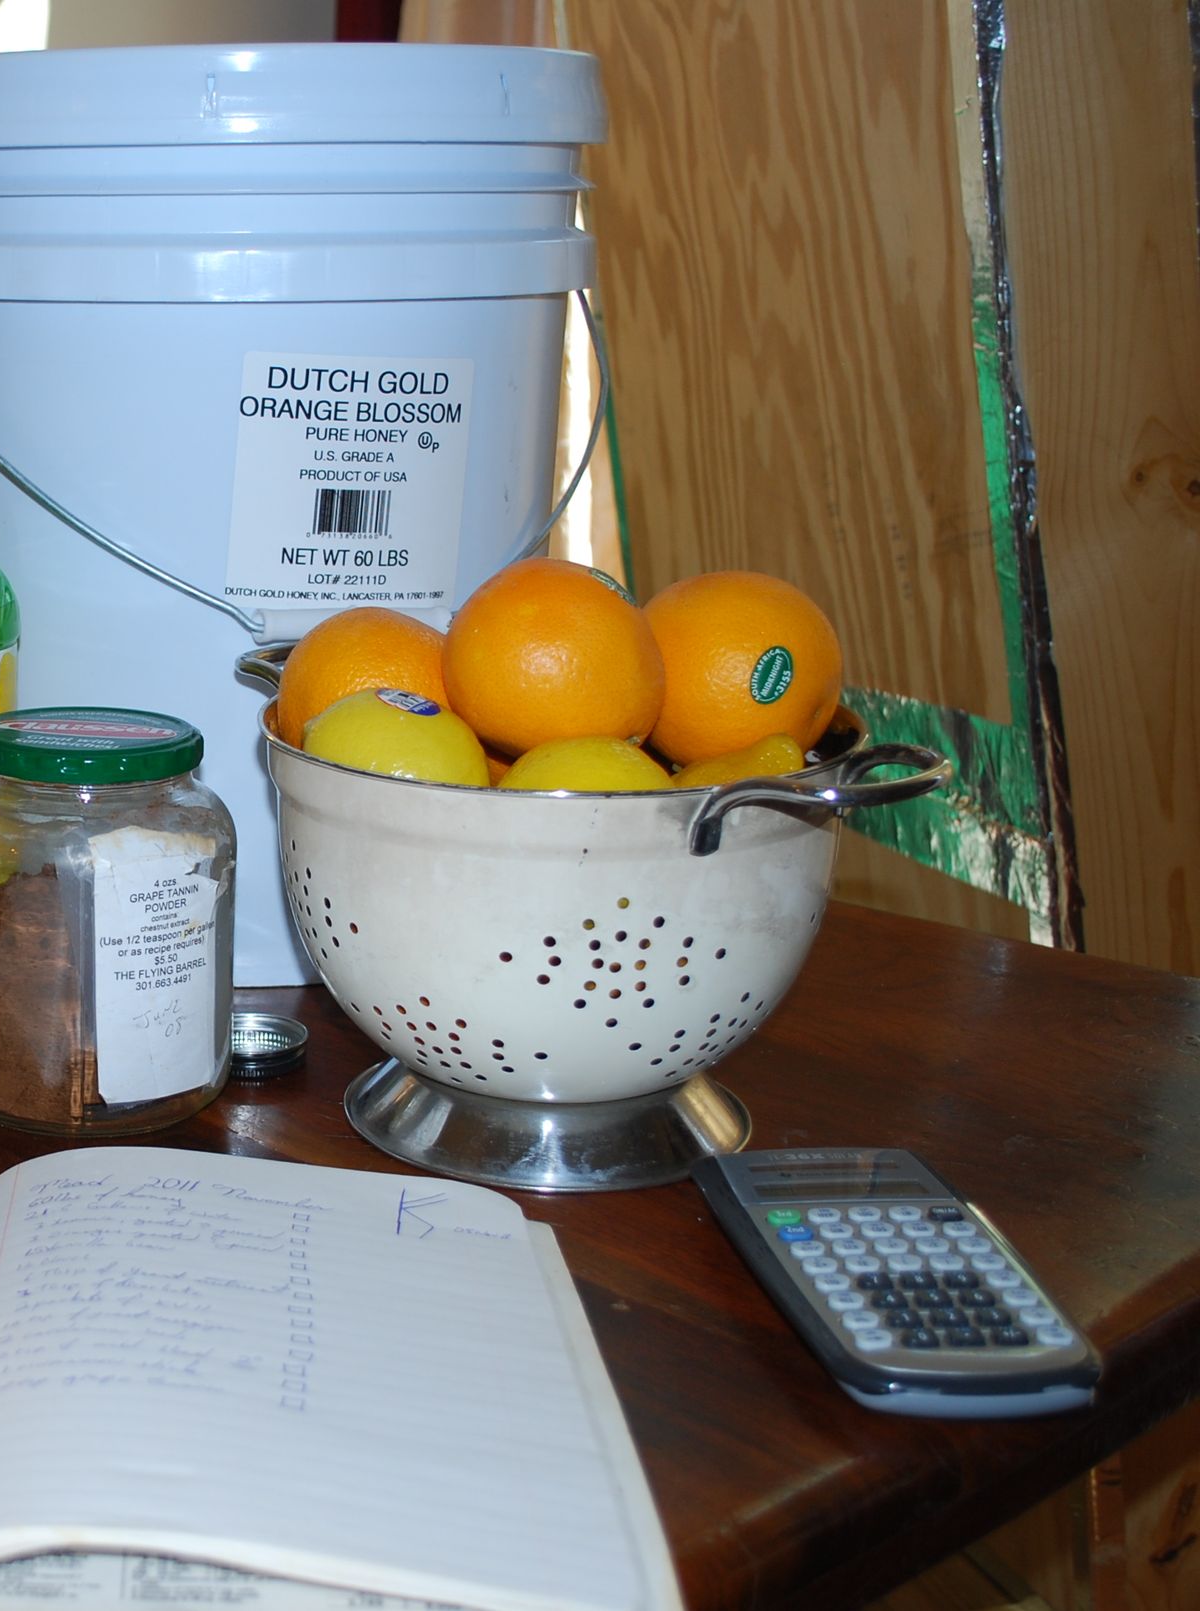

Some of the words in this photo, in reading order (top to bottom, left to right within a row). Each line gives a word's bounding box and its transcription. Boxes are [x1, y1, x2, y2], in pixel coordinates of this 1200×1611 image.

[267, 366, 369, 393] DUTCH
[378, 371, 449, 395] GOLD
[239, 396, 349, 421] ORANGE
[356, 402, 461, 423] BLOSSOM
[305, 427, 350, 442] PURE
[353, 429, 408, 443] HONEY
[314, 450, 337, 462] U.S.
[341, 451, 383, 463] GRADE
[386, 452, 395, 463] A
[300, 469, 361, 482] PRODUCT
[364, 471, 381, 482] OF
[383, 471, 407, 483] USA
[281, 547, 318, 565] NET
[323, 549, 349, 566] WT
[354, 550, 374, 567] 60
[378, 550, 409, 567] LBS
[307, 574, 341, 585] LOT#
[344, 574, 387, 585] 22111D
[224, 587, 256, 597] DUTCH
[259, 589, 285, 599] GOLD
[394, 592, 404, 600] PA
[756, 648, 781, 671] AFRICA
[760, 655, 783, 697] MIDKNIGHT
[154, 880, 160, 888] 4
[130, 890, 164, 903] GRAPE
[167, 884, 199, 898] TANNIN
[145, 898, 187, 913] POWDER
[140, 922, 169, 933] chestnut
[170, 918, 190, 929] extract
[151, 912, 178, 923] contains
[100, 937, 123, 948] (Use
[126, 935, 141, 945] 1/2
[143, 931, 182, 945] teaspoon
[183, 928, 196, 939] per
[197, 920, 215, 935] gallon
[118, 948, 129, 957] or
[131, 947, 142, 957] as
[145, 943, 172, 957] recipe
[173, 935, 205, 954] requires)
[154, 953, 178, 966] $5.50
[114, 970, 136, 981] THE
[138, 965, 174, 979] FLYING
[176, 957, 206, 973] BARREL
[144, 1176, 201, 1192] 2011
